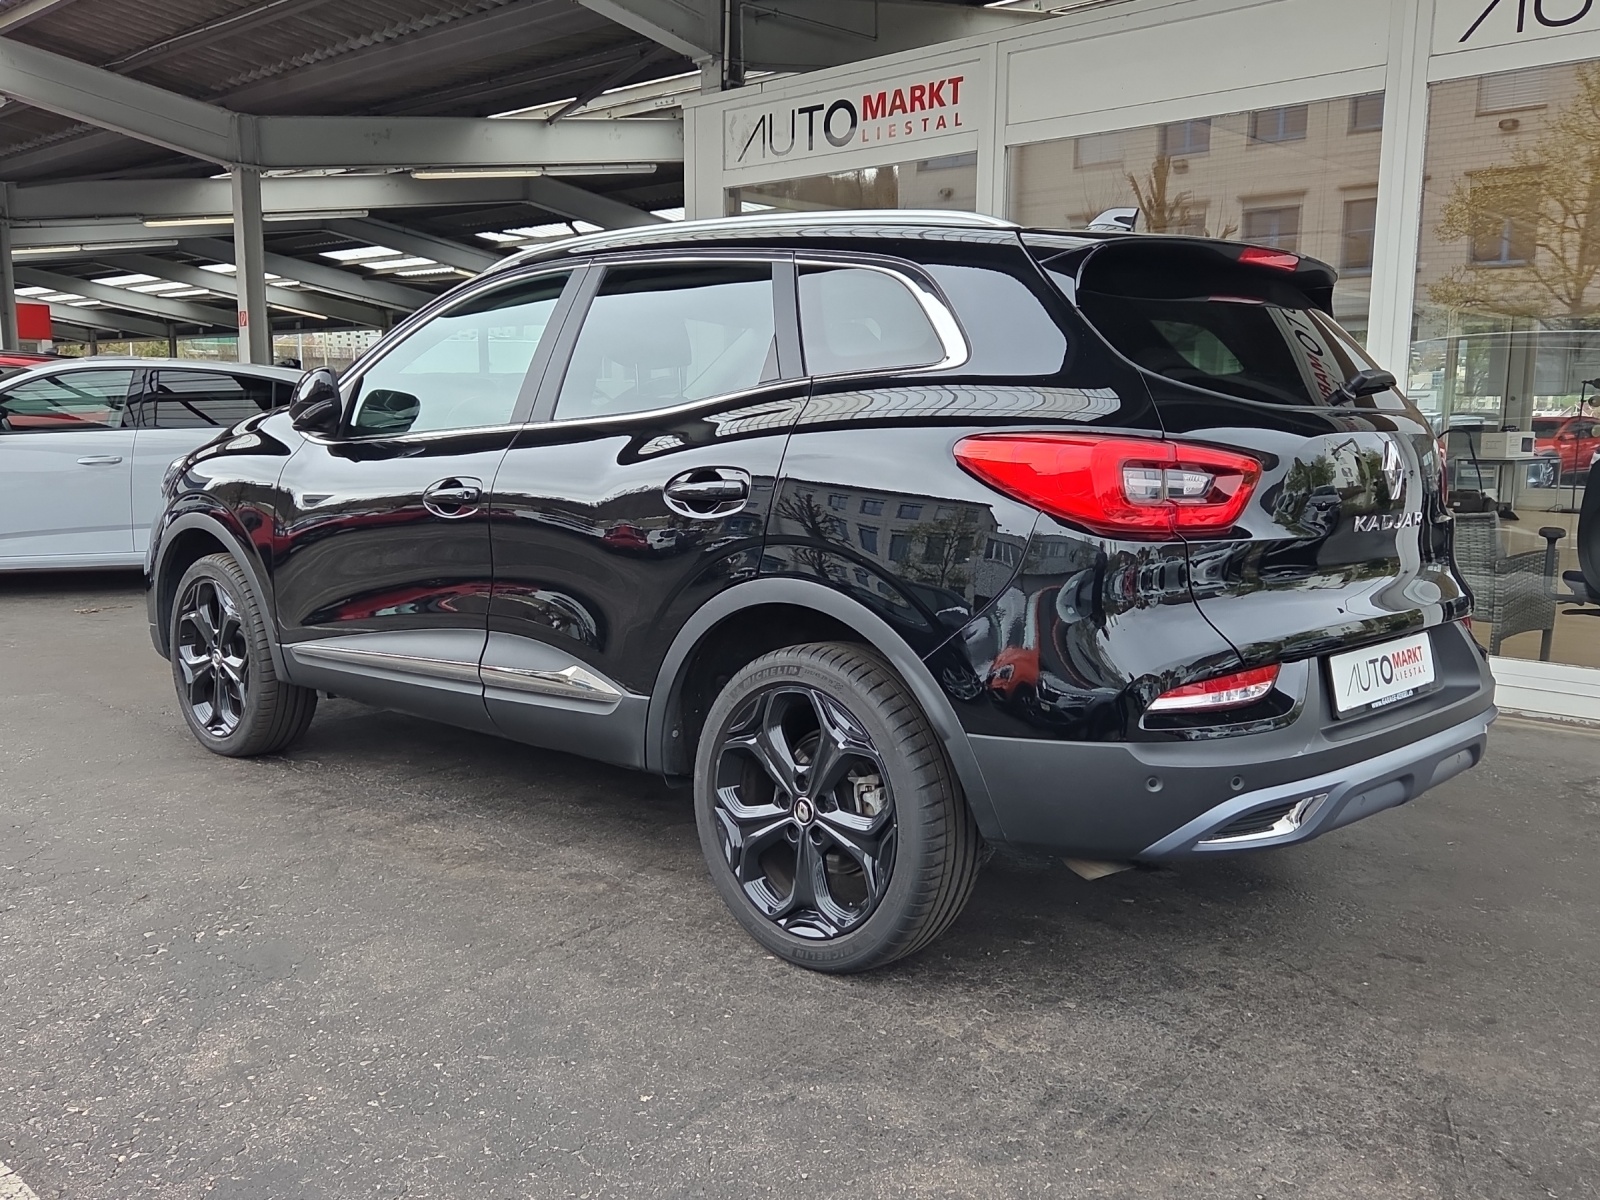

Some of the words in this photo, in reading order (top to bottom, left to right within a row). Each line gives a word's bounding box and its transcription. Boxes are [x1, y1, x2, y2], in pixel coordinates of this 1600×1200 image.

[861, 76, 964, 122] MARKT
[861, 112, 963, 143] LIESTAL
[1353, 512, 1423, 532] KADJAR
[1392, 646, 1423, 669] MARKT
[743, 665, 796, 687] MICHELIN
[1394, 664, 1426, 682] LIESTAL
